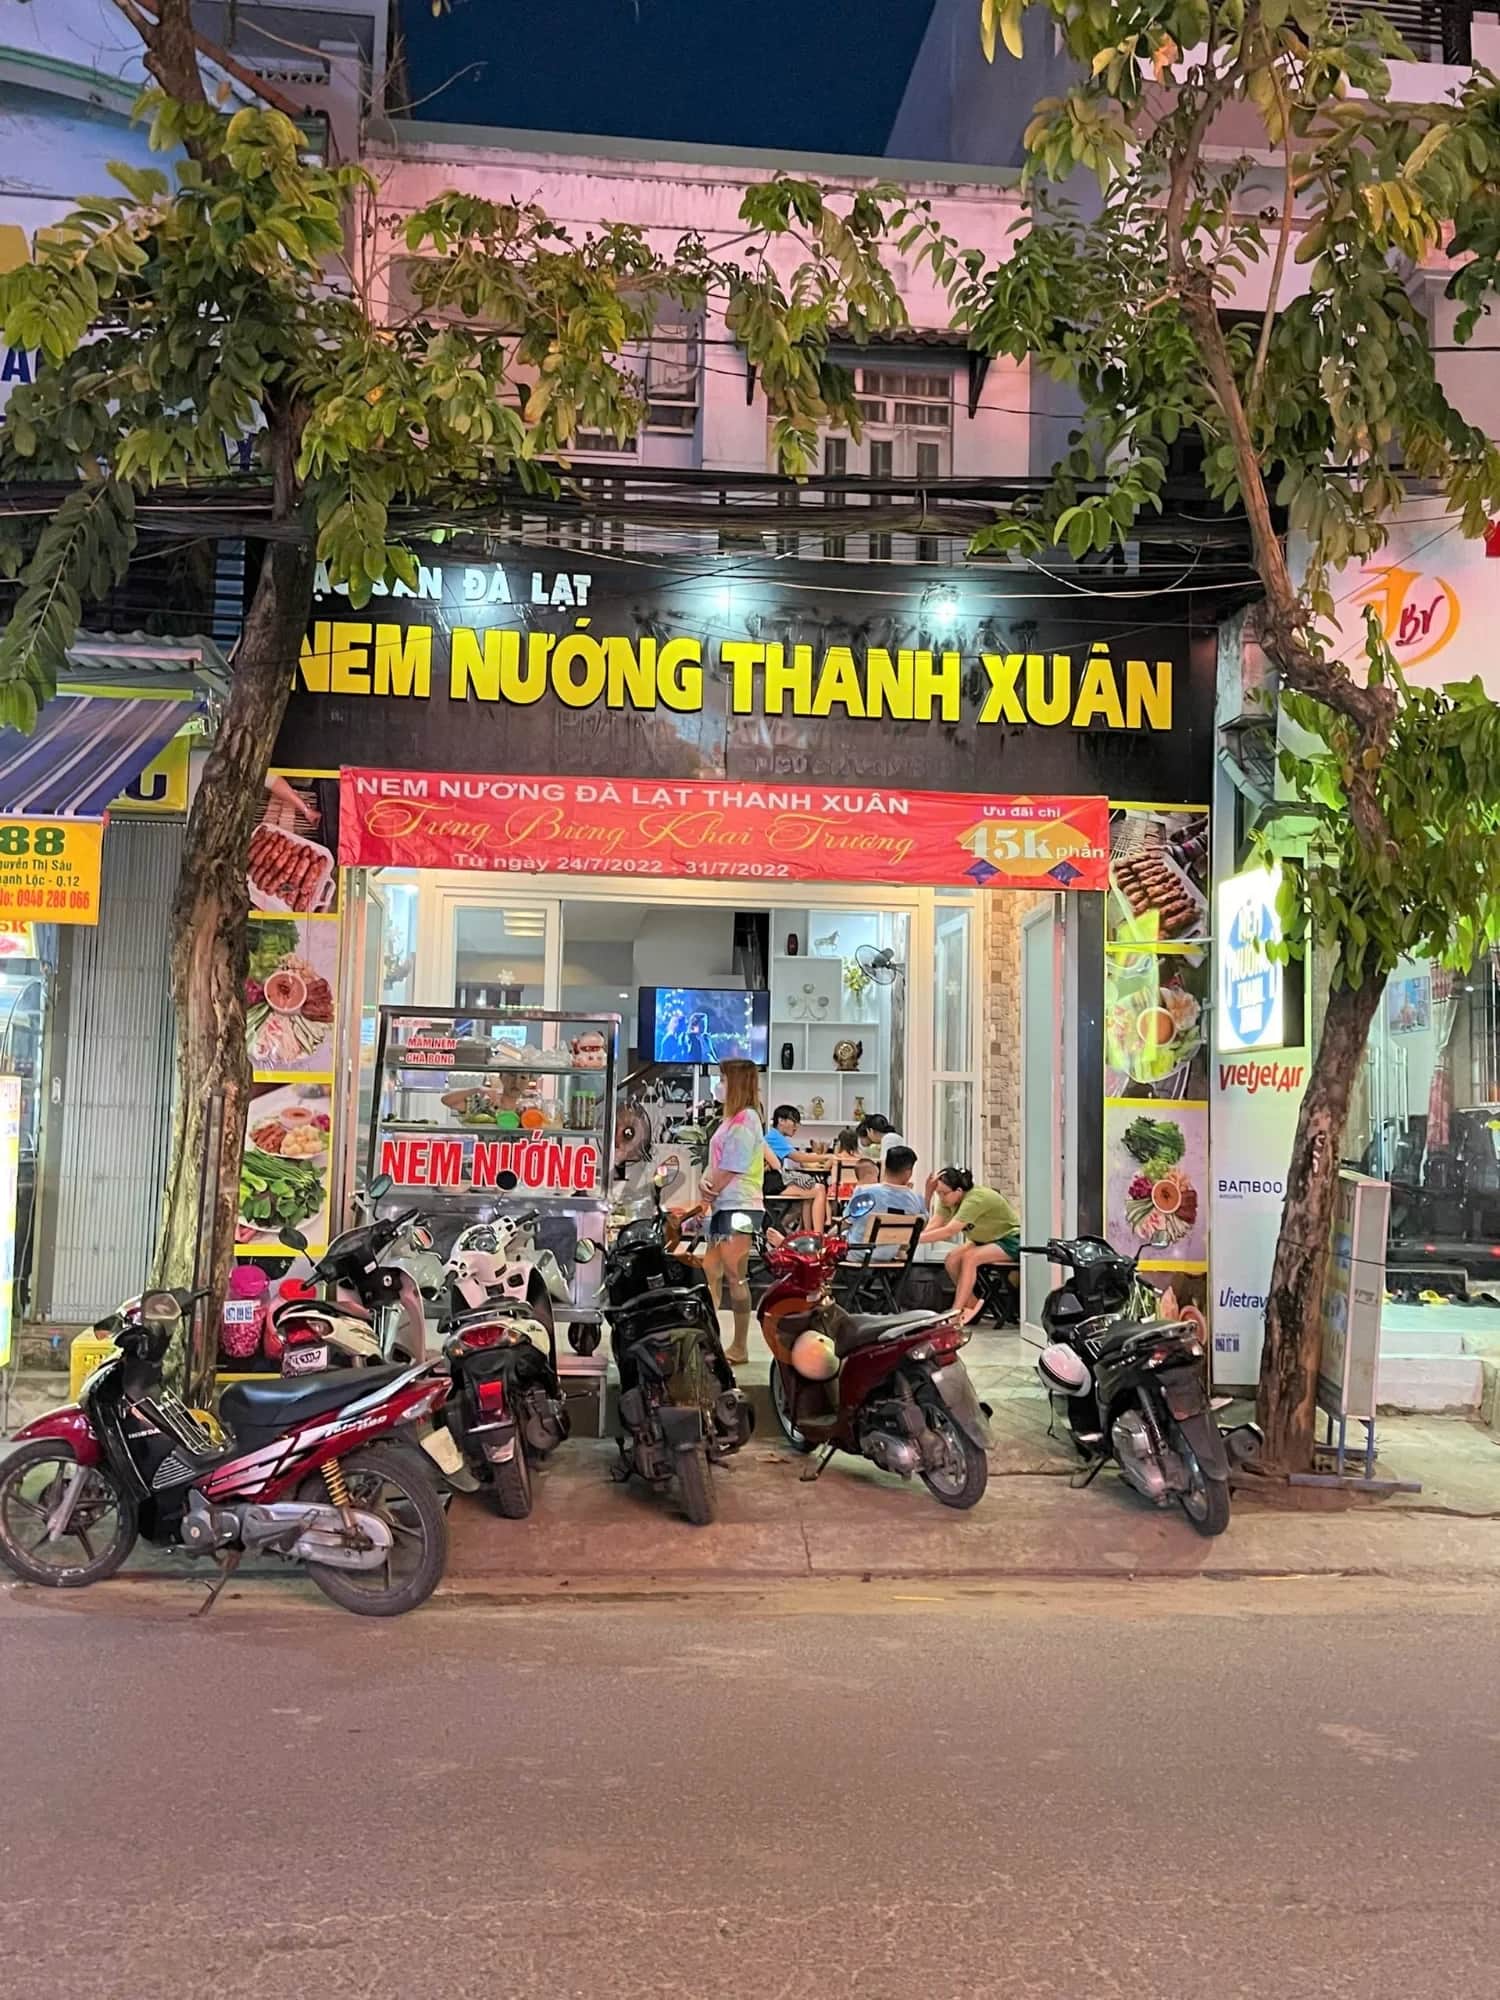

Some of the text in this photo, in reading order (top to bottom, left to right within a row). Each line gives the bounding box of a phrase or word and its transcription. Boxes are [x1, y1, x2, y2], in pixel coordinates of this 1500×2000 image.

[463, 562, 512, 604] ĐÀ
[530, 571, 592, 613] LẠT
[290, 617, 1173, 730] NEM NƯỚNG THANH XUÂN
[355, 776, 909, 815] NEM NƯƠNG ĐÀ LẠT THANH XUÂN
[982, 805, 1007, 817] Ưu
[632, 811, 754, 849] Khai
[961, 825, 1054, 860] 45k
[453, 852, 487, 869] Từ
[494, 856, 549, 872] ngày
[557, 856, 663, 873] 24/7/2022
[685, 860, 789, 877] 31/7/2022
[46, 890, 67, 909] 288
[380, 1129, 598, 1190] NEM NƯỚNG
[1218, 1180, 1282, 1194] BAMBOO
